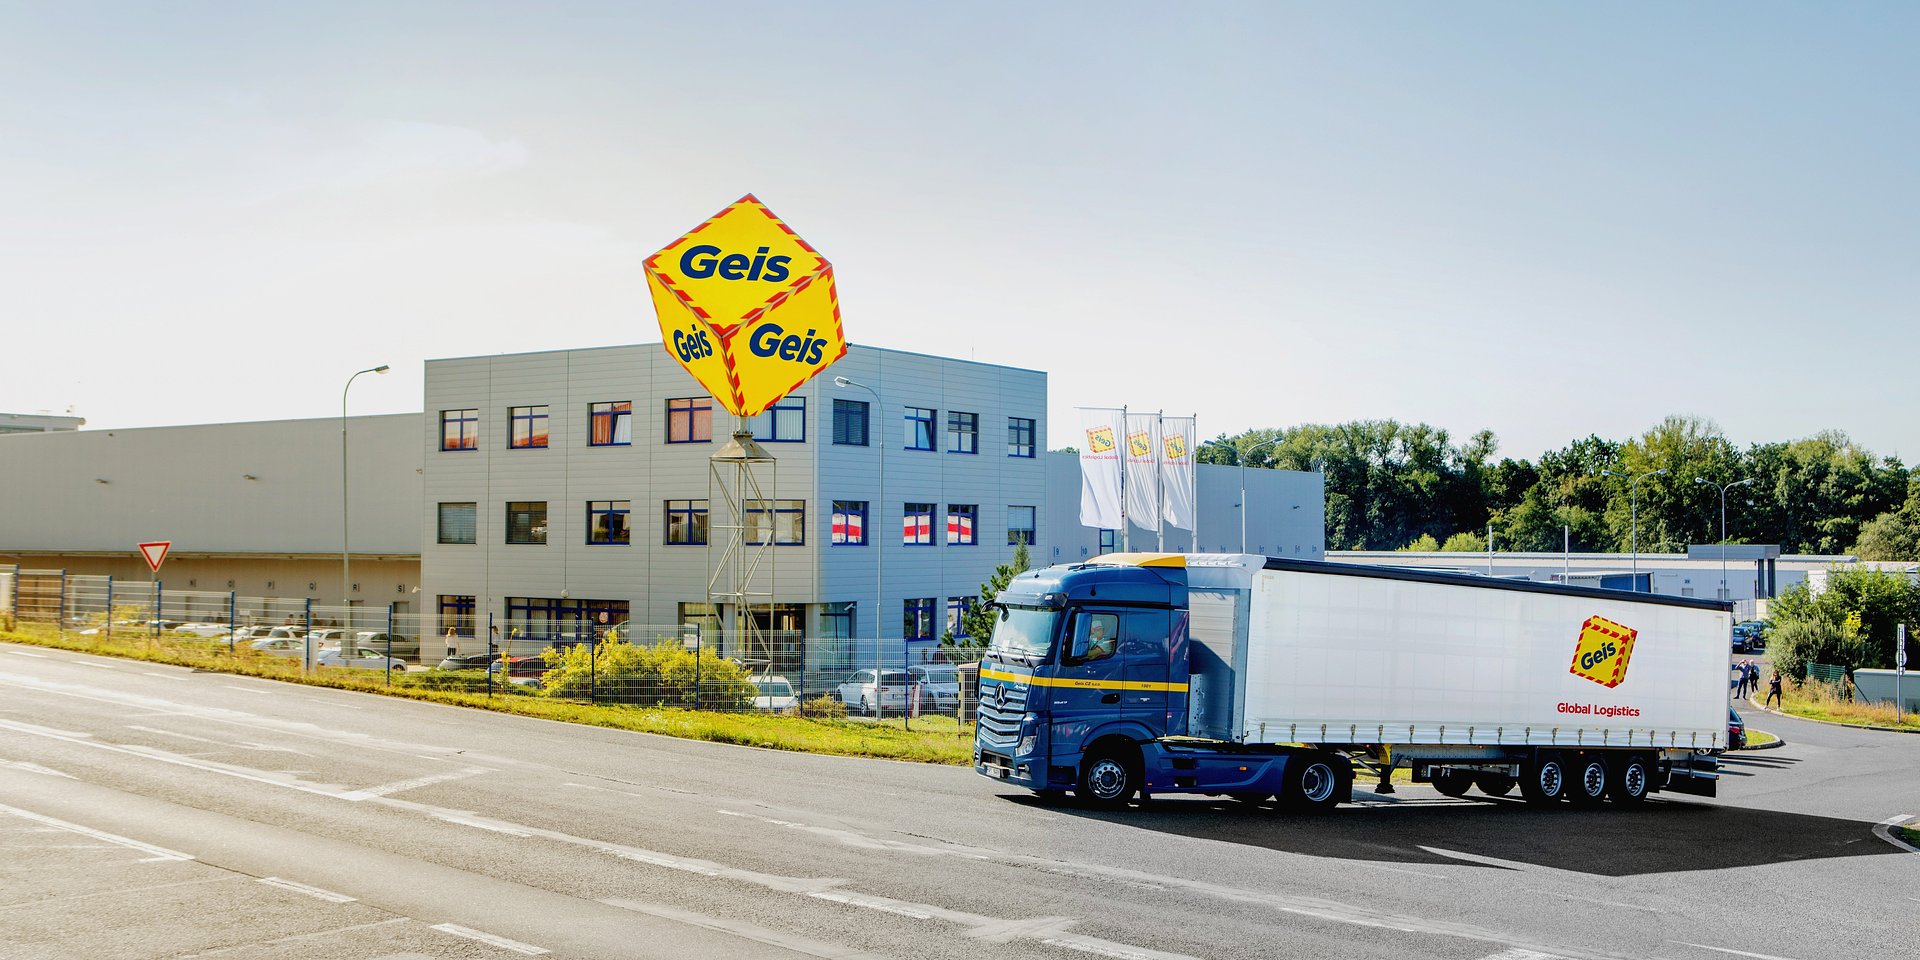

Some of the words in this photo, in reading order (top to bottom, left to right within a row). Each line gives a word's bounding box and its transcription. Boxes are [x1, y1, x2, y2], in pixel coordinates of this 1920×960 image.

[679, 244, 792, 283] Geis
[673, 324, 713, 363] Geis
[749, 323, 828, 365] Geis
[1580, 642, 1617, 670] Geis
[1557, 702, 1591, 714] Global
[1594, 704, 1640, 717] Logistics
